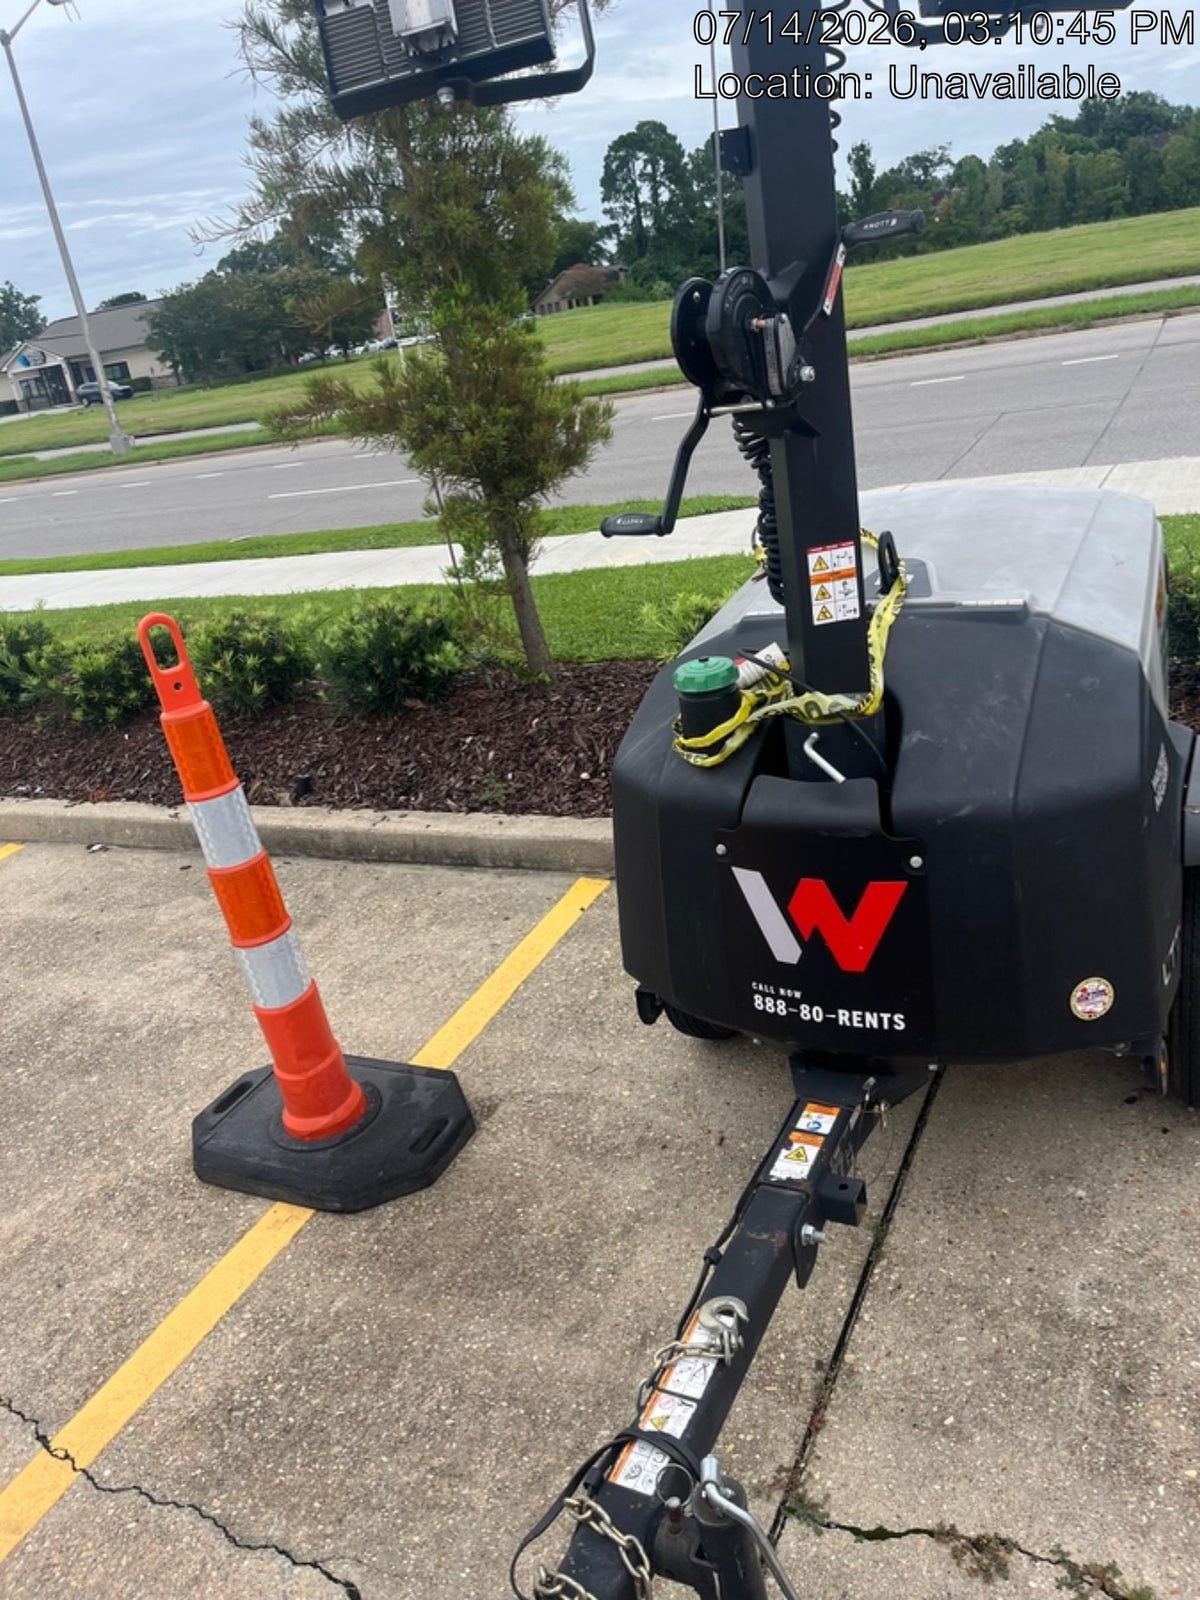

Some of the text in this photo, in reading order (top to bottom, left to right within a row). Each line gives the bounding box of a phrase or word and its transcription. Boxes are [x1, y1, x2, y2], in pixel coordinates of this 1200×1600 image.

[751, 981, 802, 999] CALL NOW
[753, 994, 906, 1030] 888-80-RENTS
